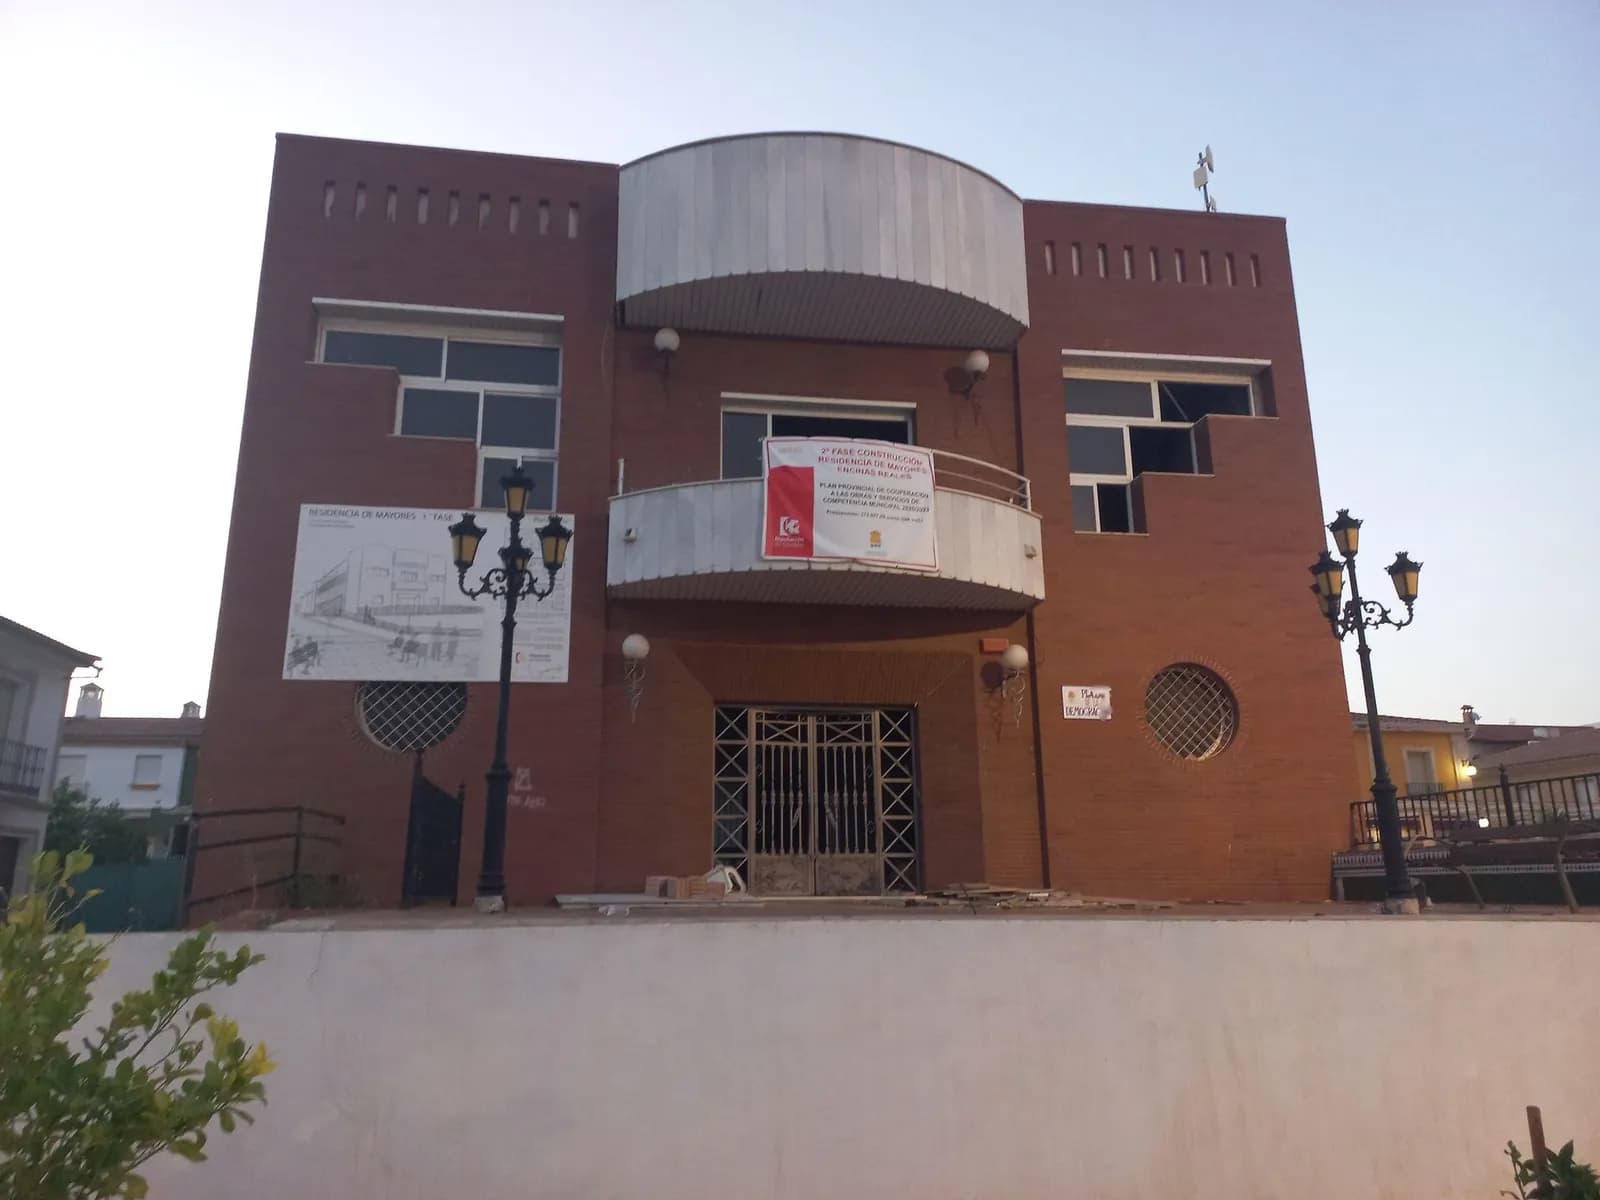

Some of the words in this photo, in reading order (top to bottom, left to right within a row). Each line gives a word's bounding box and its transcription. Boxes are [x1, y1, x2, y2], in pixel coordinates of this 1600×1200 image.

[832, 447, 854, 456] FASE
[818, 455, 872, 466] RESIDENCIA
[874, 460, 885, 468] DE
[887, 462, 927, 474] MAYORES
[837, 466, 876, 476] ENCINAS
[878, 470, 912, 479] REALES
[838, 483, 875, 492] PROVINCIAL
[823, 497, 868, 506] COMPETENCIA
[308, 508, 360, 519] RESIDENCIA
[361, 509, 372, 519] DE
[375, 511, 416, 521] MAYORES
[433, 514, 454, 522] FASE
